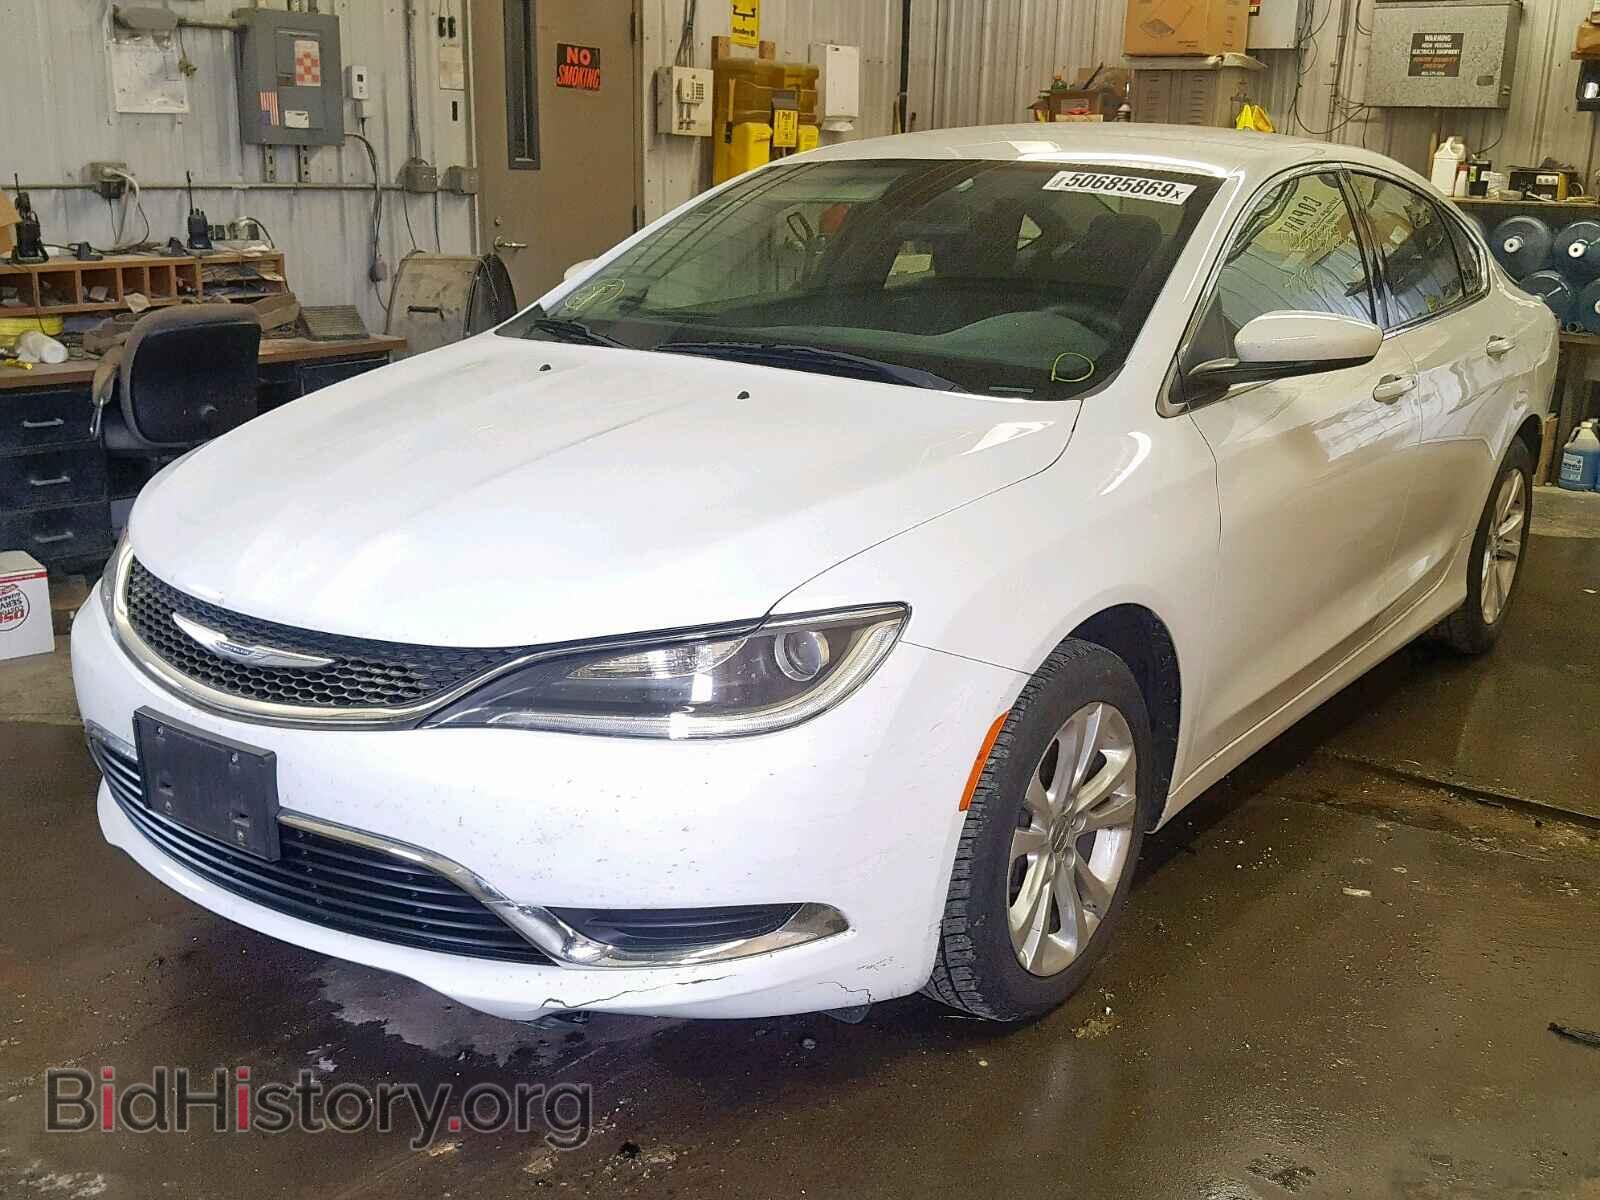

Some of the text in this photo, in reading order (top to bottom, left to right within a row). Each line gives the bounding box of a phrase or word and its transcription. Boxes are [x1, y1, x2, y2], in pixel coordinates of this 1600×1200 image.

[1424, 34, 1452, 42] WARNING
[566, 47, 591, 65] NO
[557, 64, 600, 89] SMOKING
